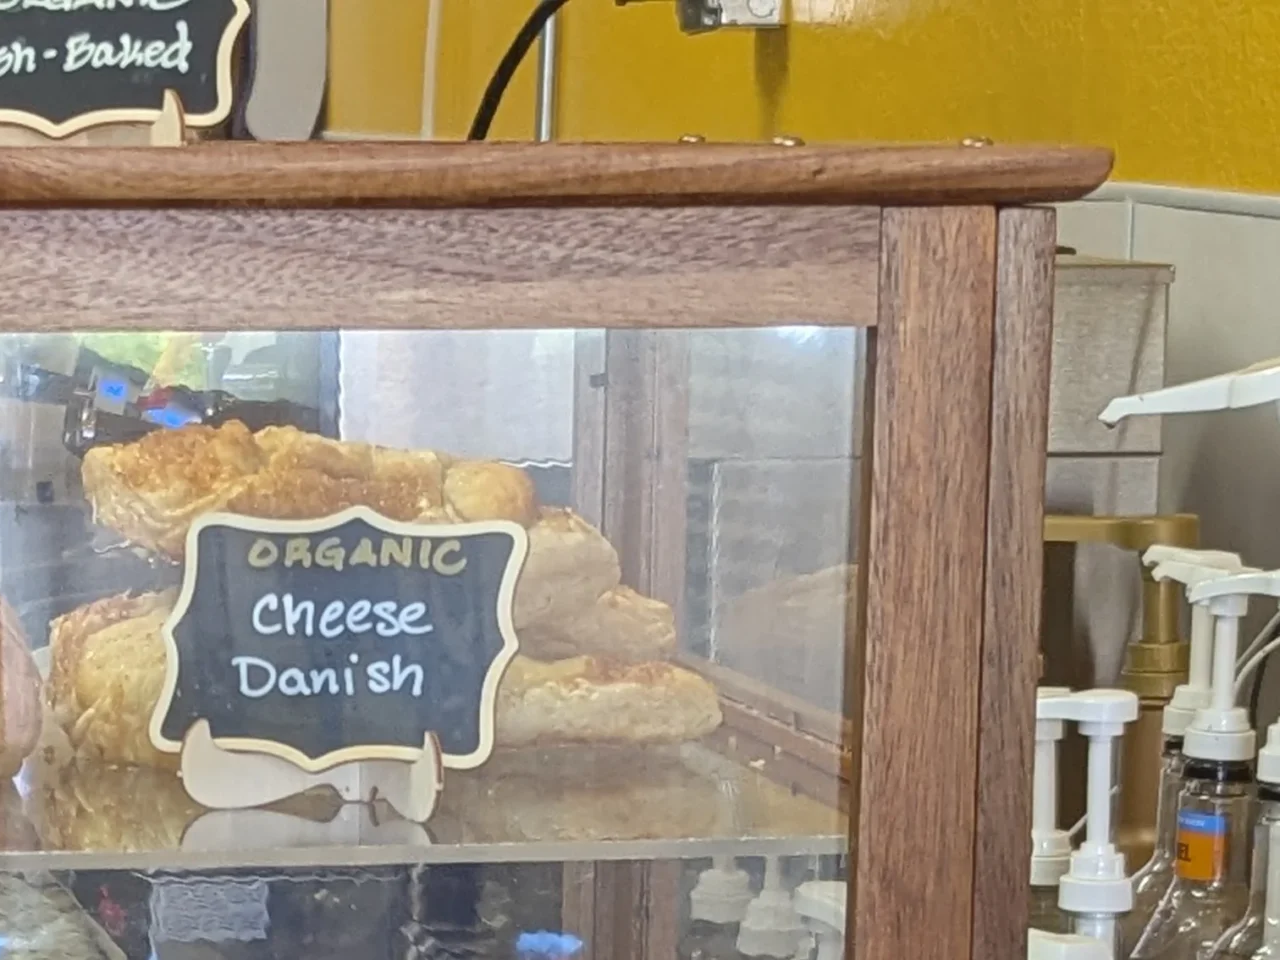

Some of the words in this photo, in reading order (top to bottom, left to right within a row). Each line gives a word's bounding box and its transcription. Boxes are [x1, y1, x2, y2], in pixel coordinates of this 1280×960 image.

[247, 535, 468, 576] ORGANIC
[251, 592, 434, 638] Cheese
[231, 653, 424, 697] Danish
